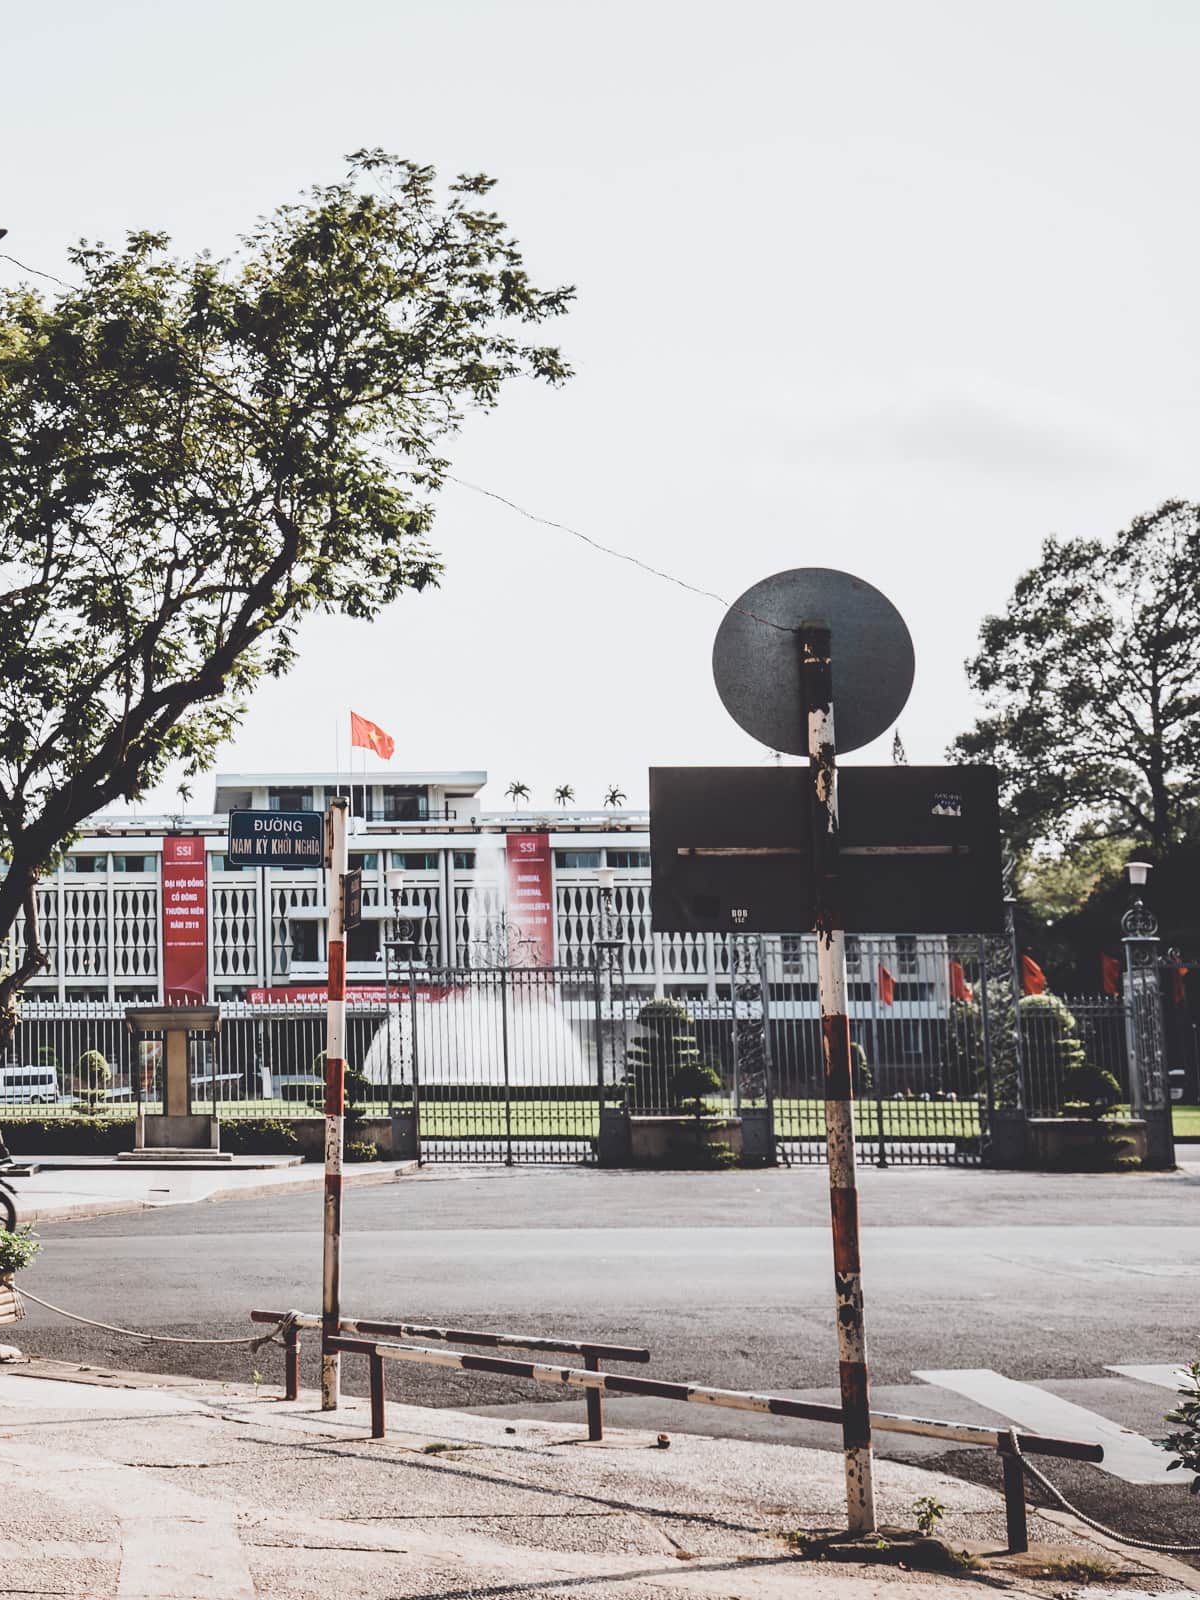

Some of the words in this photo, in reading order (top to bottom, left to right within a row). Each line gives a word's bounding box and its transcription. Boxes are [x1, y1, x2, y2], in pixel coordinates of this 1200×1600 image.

[254, 816, 303, 832] ĐƯỜNG
[176, 846, 192, 856] SSI
[232, 838, 252, 855] NAM
[520, 842, 536, 853] SSI
